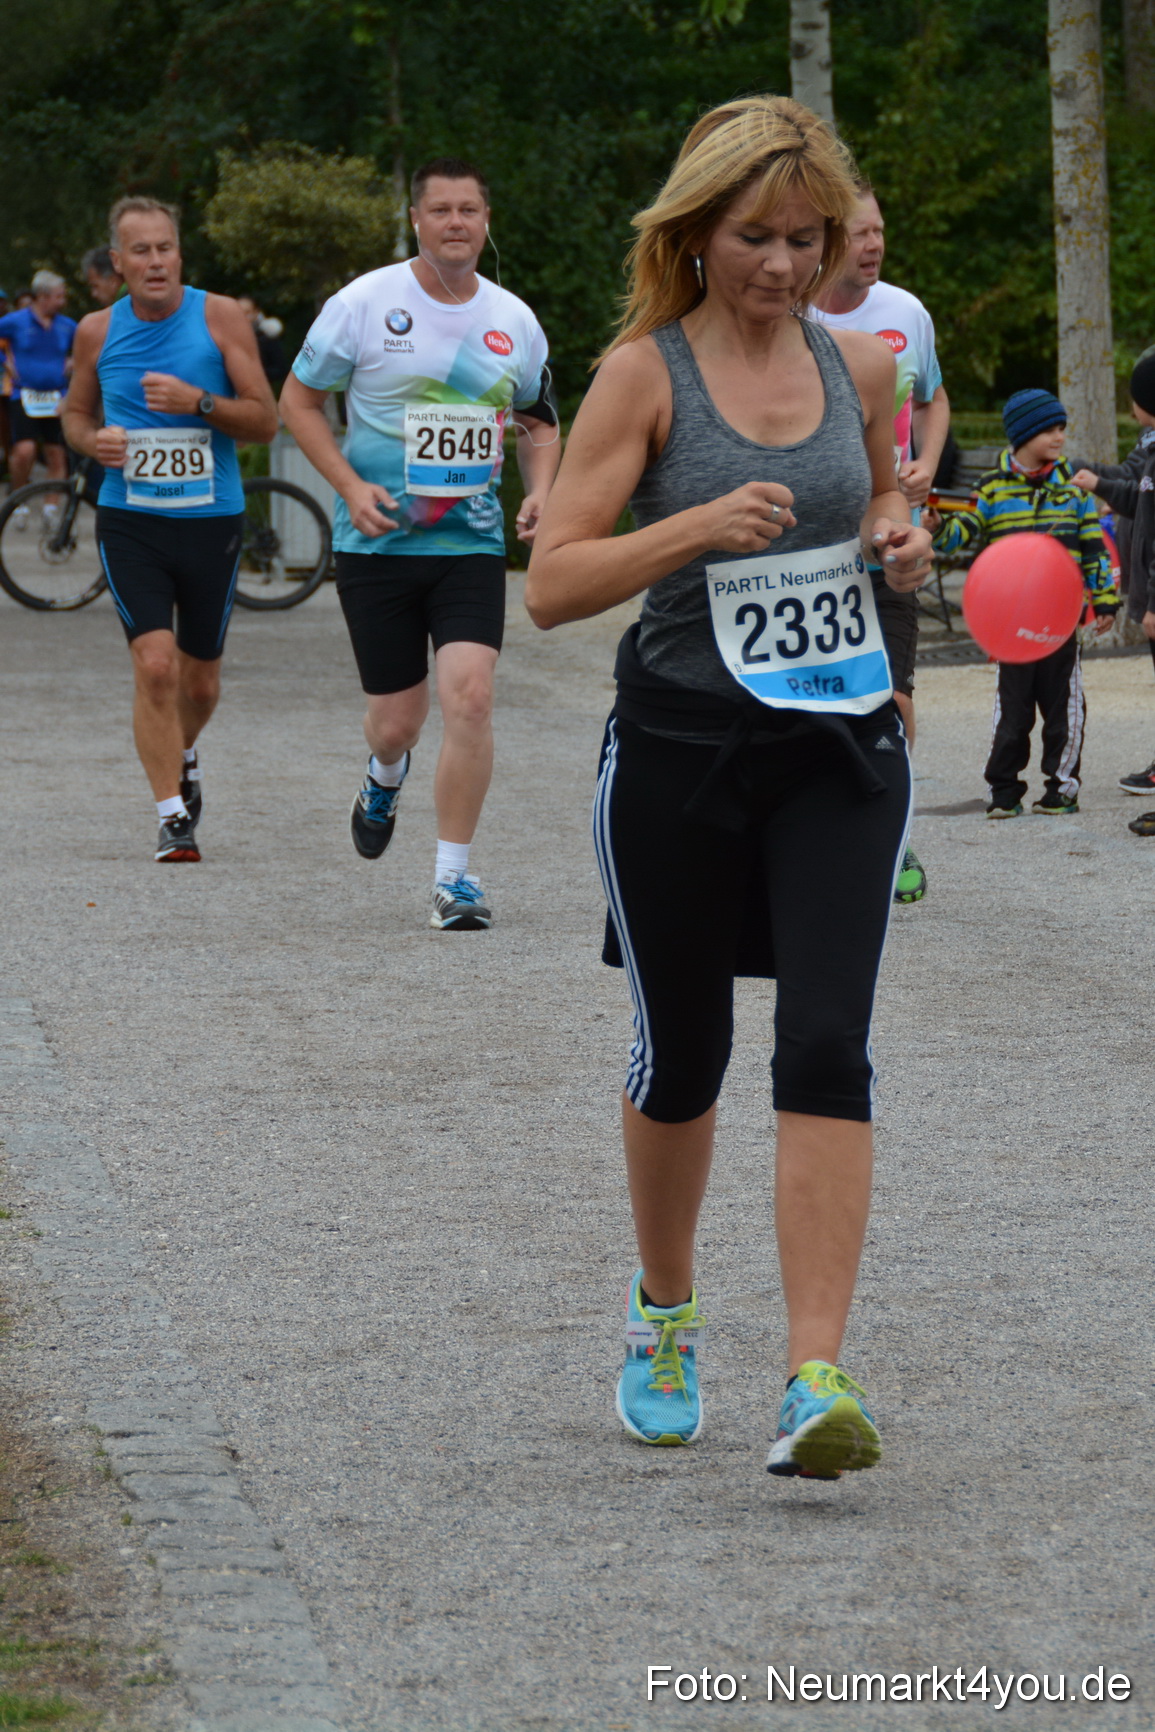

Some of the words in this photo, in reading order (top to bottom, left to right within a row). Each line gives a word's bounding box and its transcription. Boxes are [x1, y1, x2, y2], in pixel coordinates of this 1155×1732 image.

[384, 339, 414, 347] PARTL
[408, 413, 441, 422] PARTL
[416, 427, 492, 460] 2649
[134, 448, 204, 477] 2289
[444, 470, 466, 483] Jan
[154, 484, 185, 496] Josef
[714, 575, 776, 596] PARTL
[780, 562, 853, 587] Neumarkt
[735, 584, 866, 665] 2333
[786, 675, 845, 697] Petra
